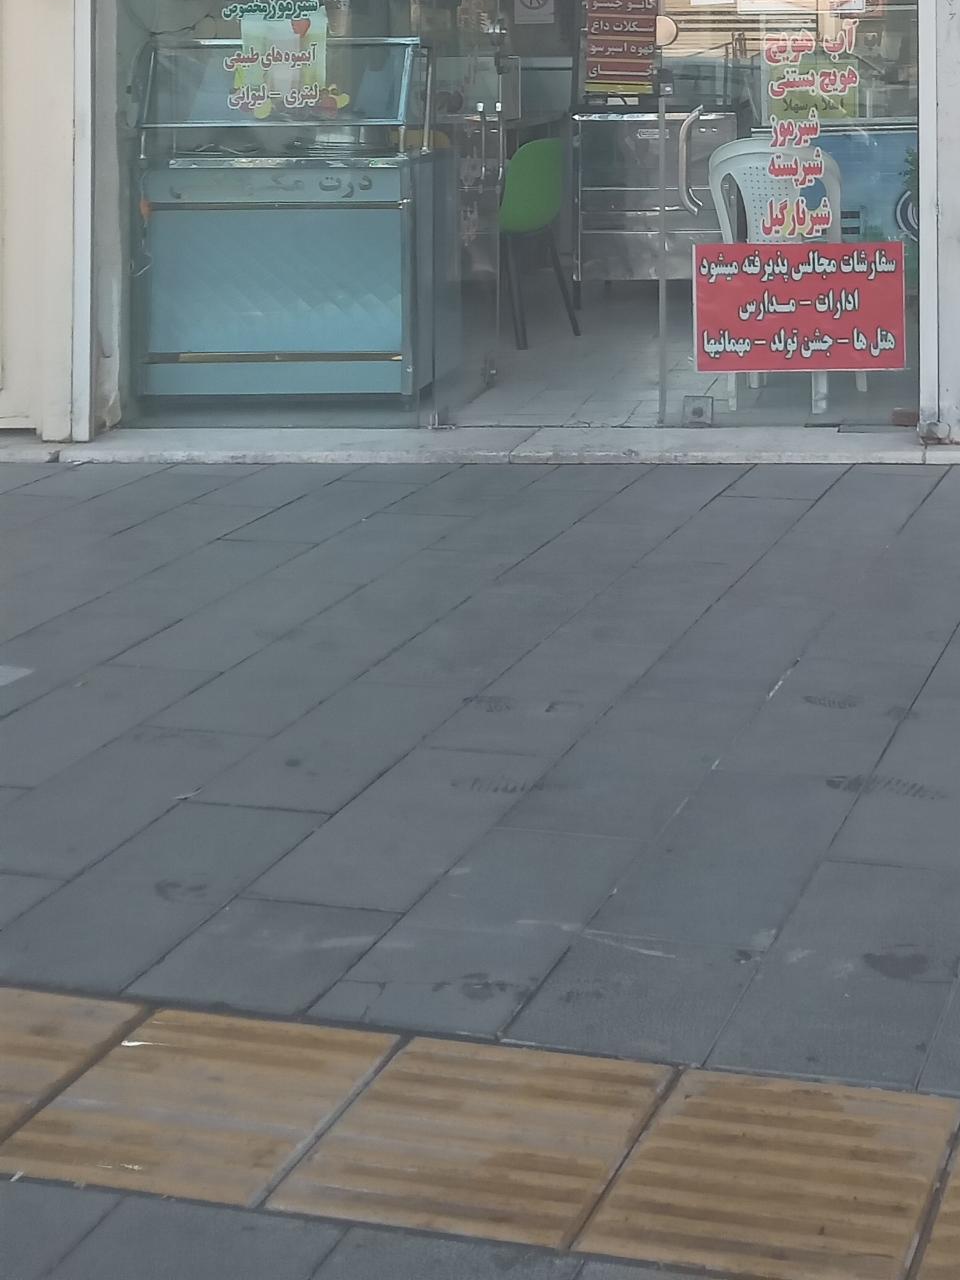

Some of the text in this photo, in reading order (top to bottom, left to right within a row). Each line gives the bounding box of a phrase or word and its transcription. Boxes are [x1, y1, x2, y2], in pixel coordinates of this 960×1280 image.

[764, 19, 859, 64] آب هویج
[224, 47, 259, 70] طبیعی
[227, 84, 267, 109] لیوانی
[284, 84, 321, 108] لیتری
[769, 66, 859, 97] هویج بستنی
[700, 249, 896, 283] سفارشات مجالس پذیرفته میشود
[738, 290, 797, 321] مدارس
[815, 289, 860, 319] ادارات
[703, 330, 751, 359] مهمانیها
[770, 329, 799, 359] تولد
[801, 329, 833, 358] جشن
[853, 327, 868, 350] ها
[870, 326, 896, 357] هتل
